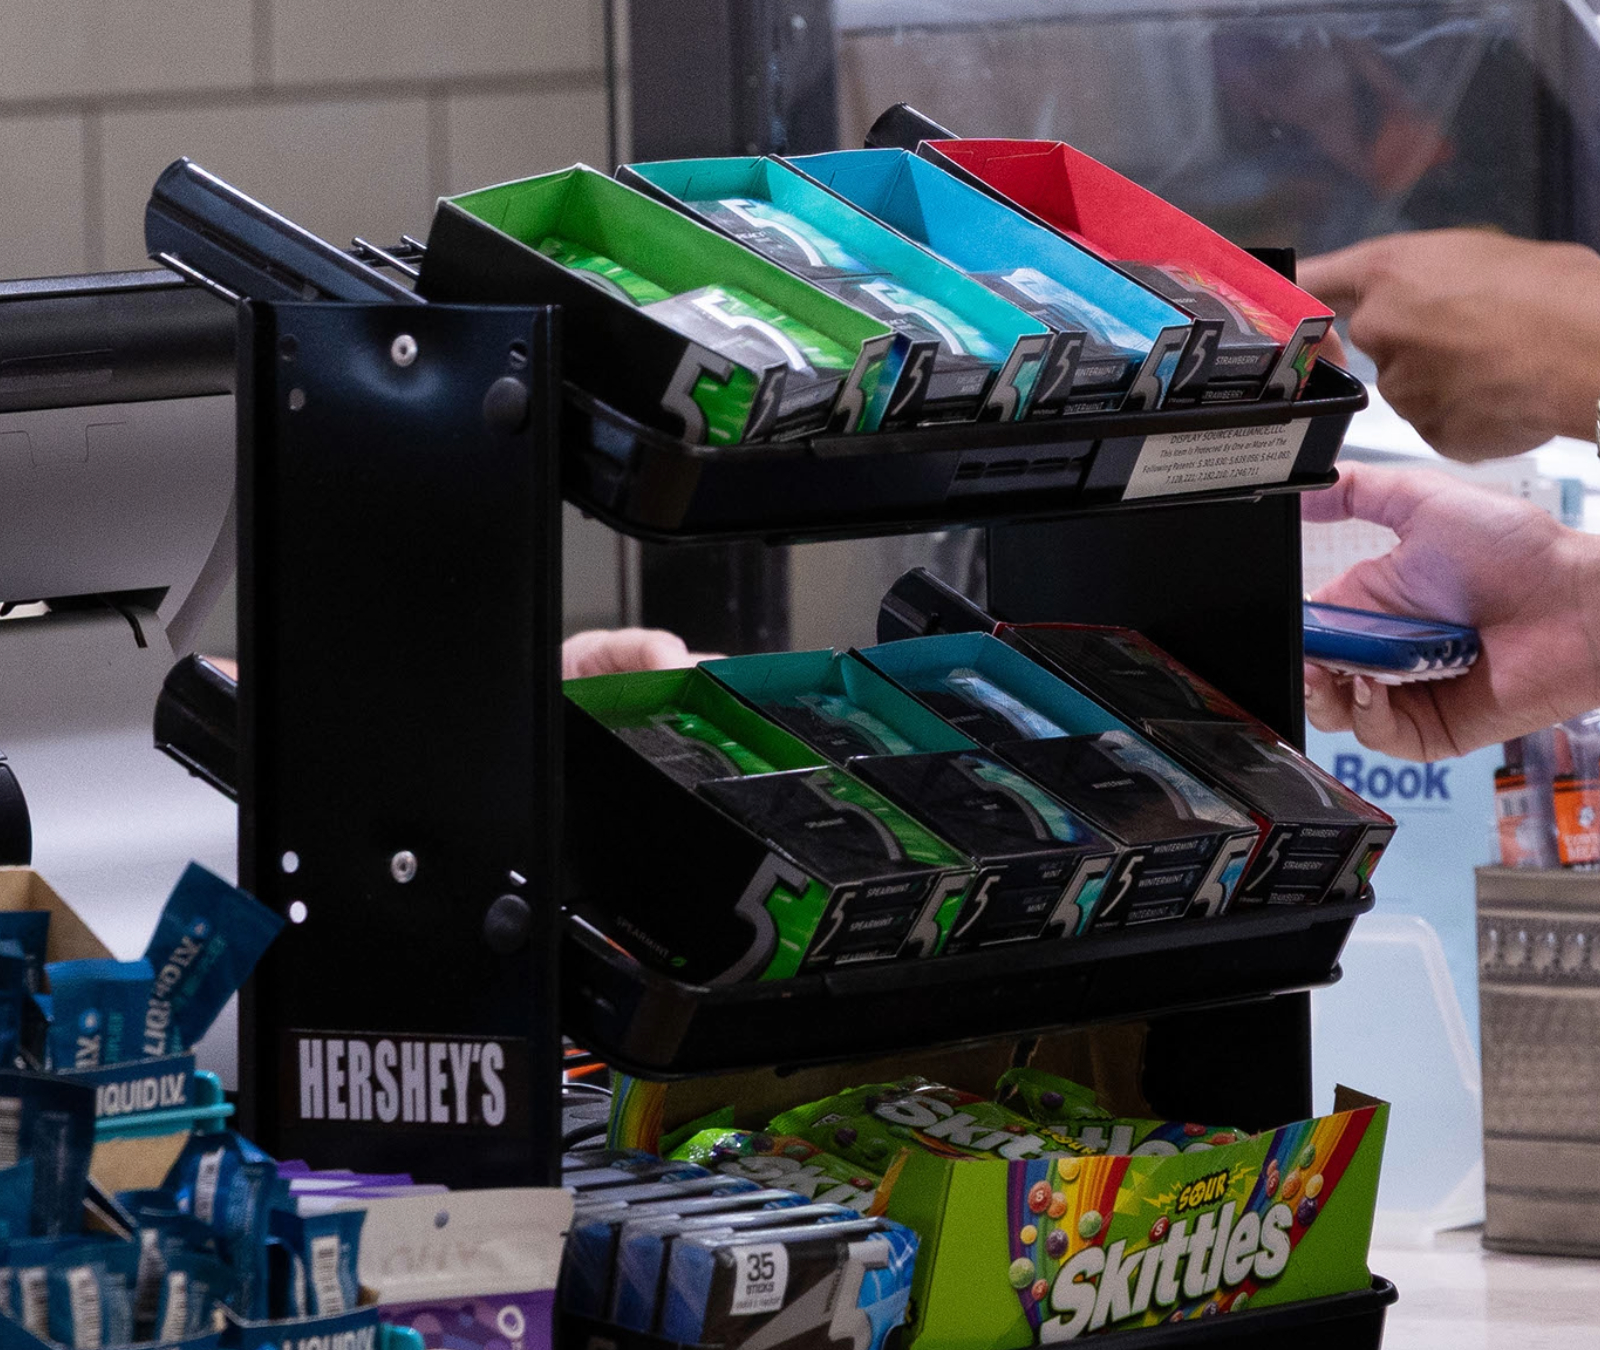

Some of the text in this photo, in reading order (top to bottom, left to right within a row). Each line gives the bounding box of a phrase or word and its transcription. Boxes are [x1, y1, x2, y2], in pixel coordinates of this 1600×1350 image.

[1215, 355, 1260, 366] STRAWBERRY
[1203, 390, 1245, 400] TRAWBERRY
[1170, 434, 1201, 444] DISPLAY
[1202, 429, 1234, 441] SOURCE
[1231, 442, 1244, 451] One
[1253, 440, 1268, 449] More
[1276, 437, 1287, 446] The
[1143, 464, 1172, 474] Following
[1333, 753, 1451, 800] Book
[1299, 827, 1340, 839] STRAWBERRY
[1153, 840, 1198, 854] WINTERMINT
[1282, 860, 1324, 871] STRAWBERRY
[1138, 874, 1184, 888] WINTERMINT
[866, 883, 911, 898] SPEARMINT
[1268, 892, 1307, 902] TRAWBERRY
[850, 917, 894, 932] SPEARMINT
[299, 1039, 506, 1126] HERSHEY'S
[96, 1078, 158, 1117] IQUID
[1177, 1172, 1228, 1211] SOUR
[747, 1252, 775, 1282] 35
[1040, 1201, 1293, 1344] Skittles
[746, 1282, 774, 1295] STICKS
